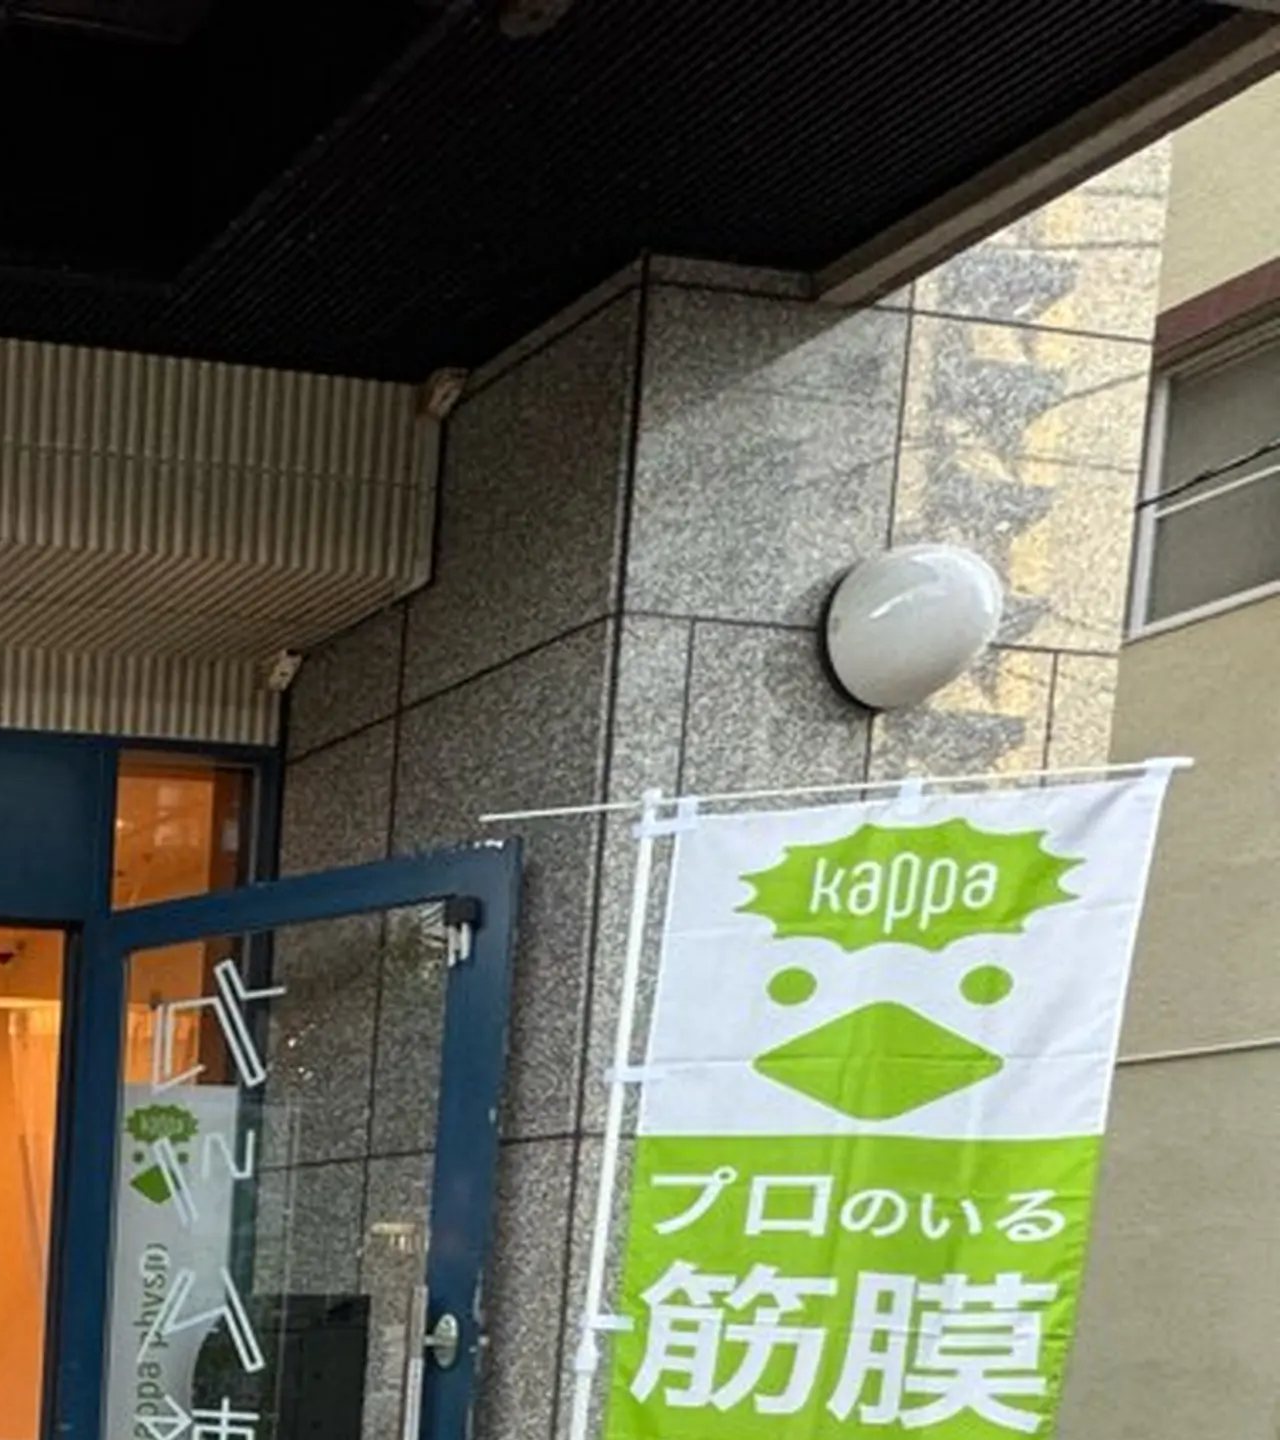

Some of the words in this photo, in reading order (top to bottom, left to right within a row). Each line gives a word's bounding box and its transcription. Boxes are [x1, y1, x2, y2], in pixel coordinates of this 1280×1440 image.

[810, 852, 999, 934] kappa
[651, 1165, 1066, 1244] プロのいる
[630, 1260, 1058, 1435] 筋膜
